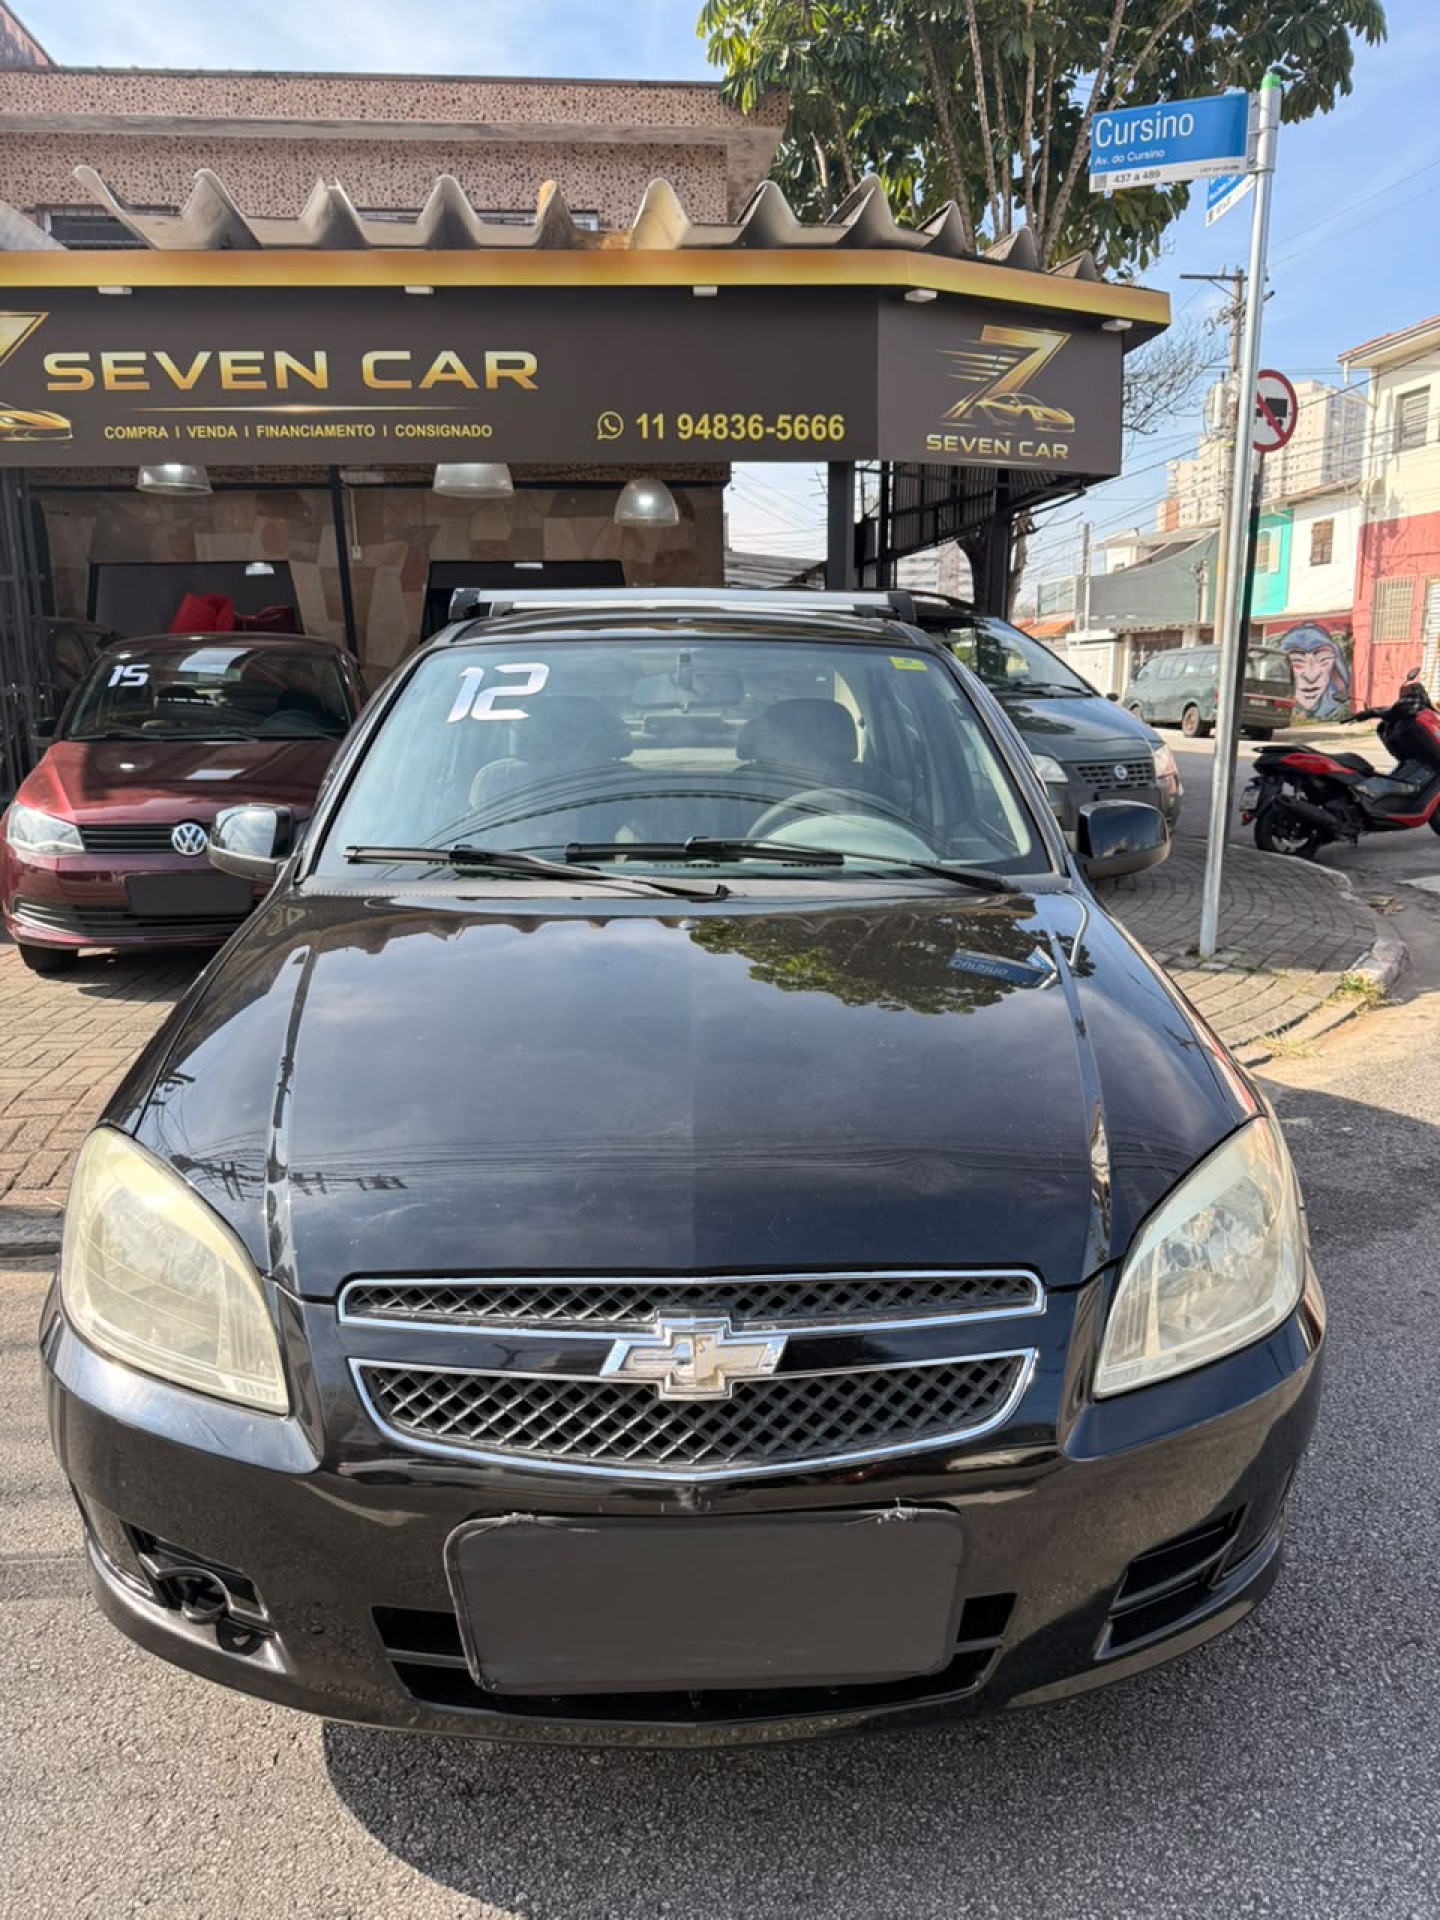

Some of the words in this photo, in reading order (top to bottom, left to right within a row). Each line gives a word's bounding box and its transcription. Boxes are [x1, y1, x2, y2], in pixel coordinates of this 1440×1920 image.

[1095, 111, 1195, 148] Cursino
[1094, 155, 1109, 166] Av.
[1112, 153, 1126, 165] do
[1127, 149, 1165, 163] Cursino
[1113, 173, 1132, 183] 437
[43, 350, 329, 392] SEVEN
[361, 350, 539, 391] CAR
[103, 425, 169, 440] COMPRA
[186, 424, 238, 439] VENDA
[256, 423, 376, 439] FINANCIAMENTO
[394, 423, 493, 438] CONSIGNADO
[635, 412, 665, 440] 11
[676, 412, 846, 442] 94836-5666
[926, 433, 1011, 456] SEVEN
[1018, 440, 1069, 460] CAR
[107, 664, 151, 688] 15
[446, 662, 550, 724] 12
